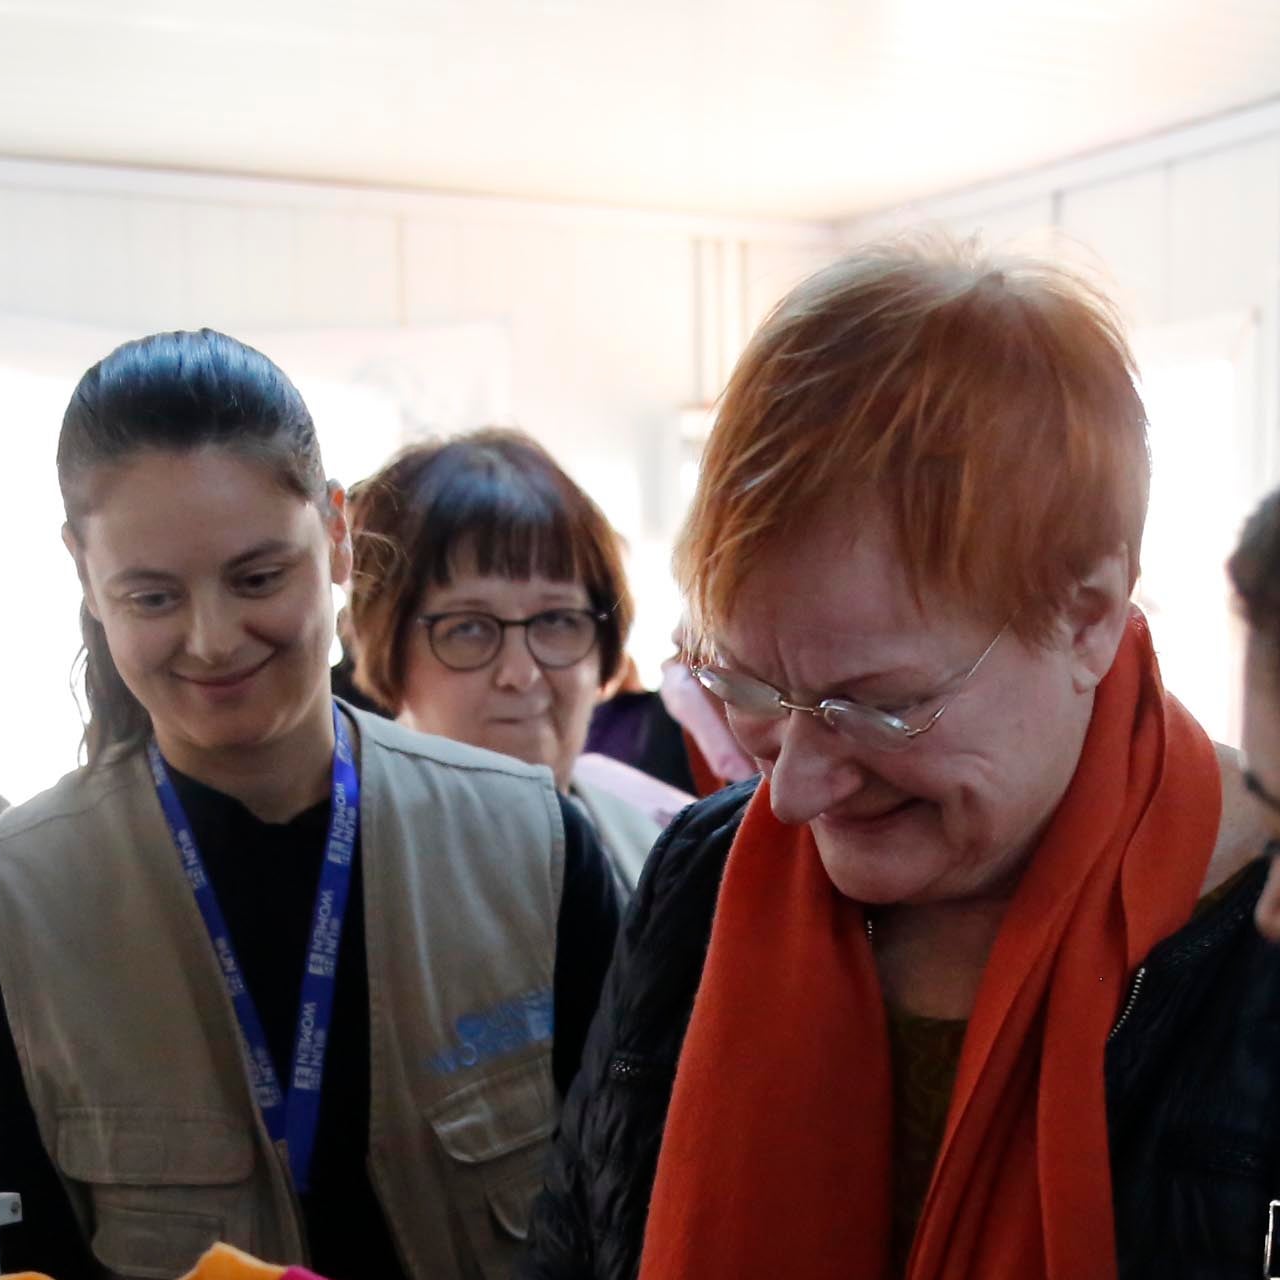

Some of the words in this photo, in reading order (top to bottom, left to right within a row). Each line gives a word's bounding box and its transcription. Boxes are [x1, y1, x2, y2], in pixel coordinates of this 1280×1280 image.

[331, 783, 346, 840] WOMEN
[312, 890, 334, 951] WOMEN
[325, 931, 338, 954] UN
[297, 1002, 317, 1065] WOMEN
[310, 1043, 325, 1066] UN
